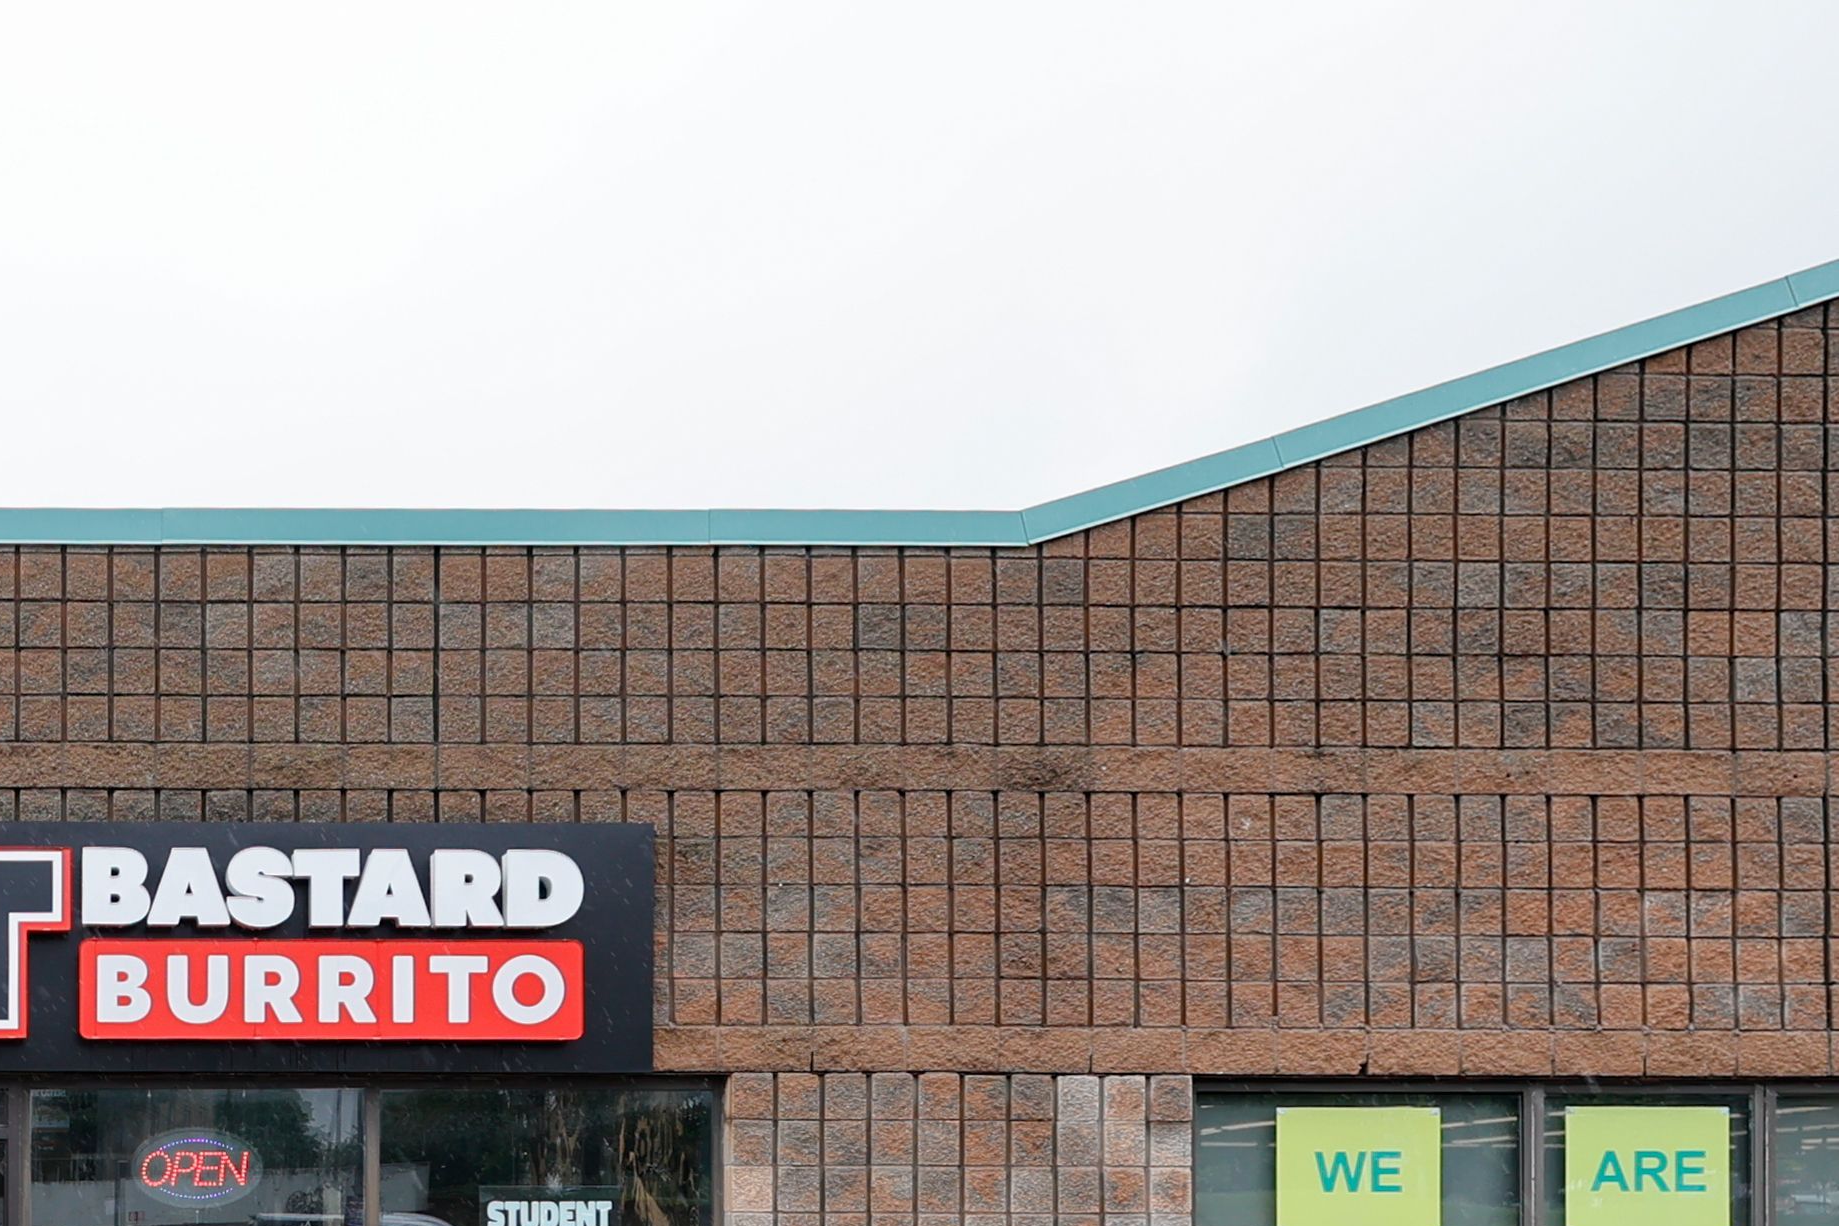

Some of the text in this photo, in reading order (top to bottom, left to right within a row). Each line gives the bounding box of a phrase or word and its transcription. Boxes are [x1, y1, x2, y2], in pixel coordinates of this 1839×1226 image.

[81, 845, 585, 929] BASTARD
[95, 953, 567, 1026] BURRITO
[140, 1150, 251, 1188] OPEN
[1314, 1149, 1404, 1193] WE
[1590, 1149, 1708, 1193] ARE
